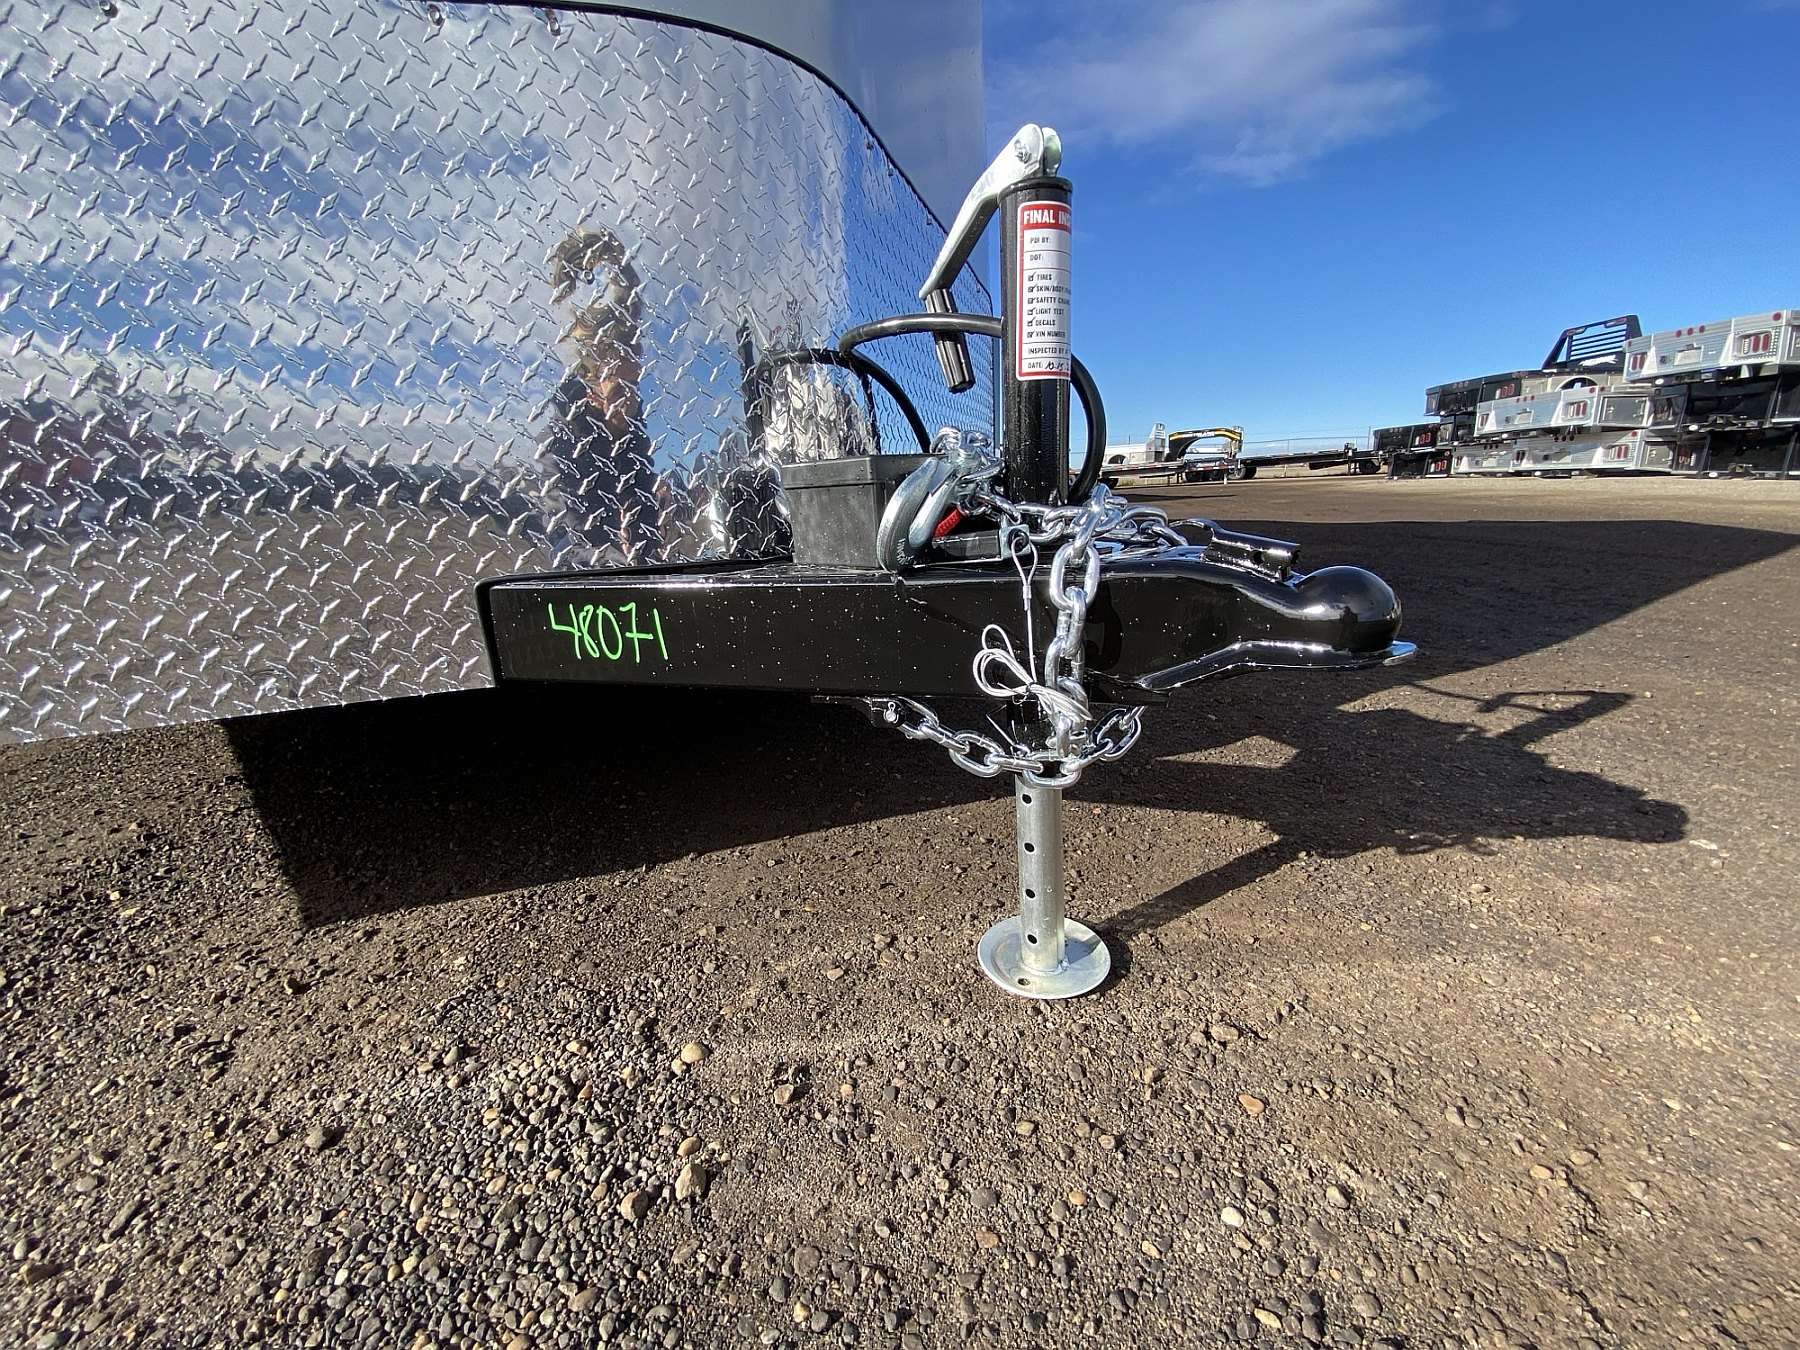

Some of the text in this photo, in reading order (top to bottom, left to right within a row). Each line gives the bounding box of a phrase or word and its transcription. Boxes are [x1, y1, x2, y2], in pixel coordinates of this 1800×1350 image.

[1024, 209, 1056, 225] FINAL
[1036, 273, 1052, 281] TIRES
[1036, 296, 1056, 304] SAFETY
[1035, 307, 1051, 315] LIGHT
[1036, 330, 1046, 338] VIN
[1028, 346, 1057, 355] INSPECTED
